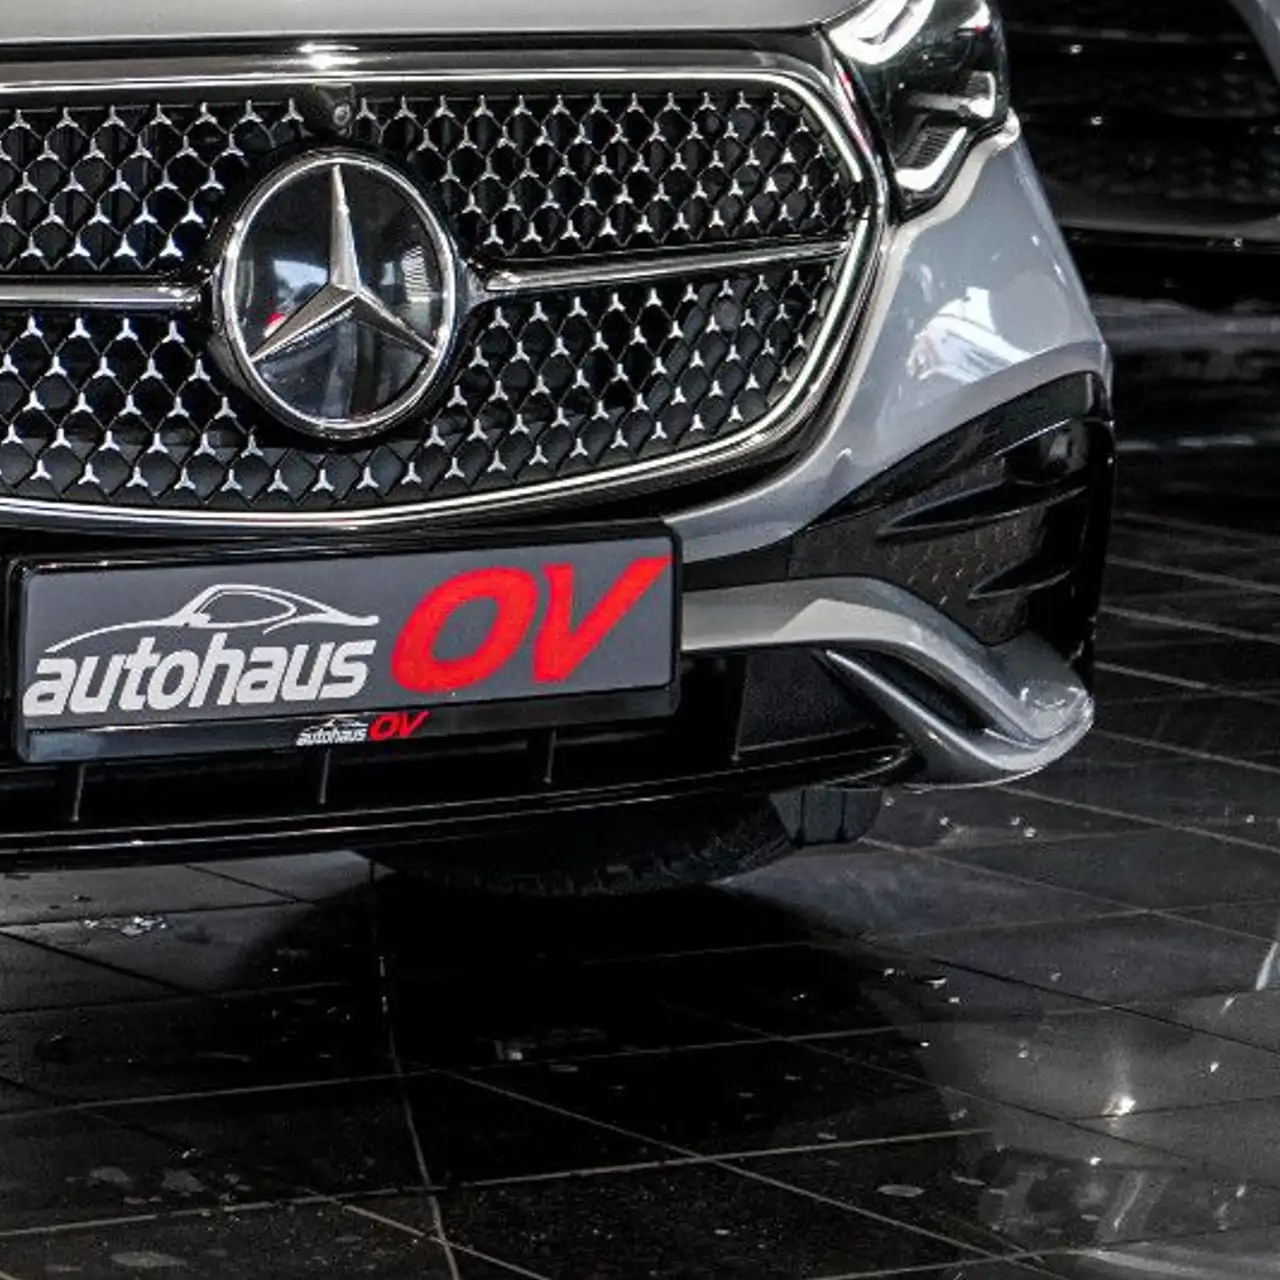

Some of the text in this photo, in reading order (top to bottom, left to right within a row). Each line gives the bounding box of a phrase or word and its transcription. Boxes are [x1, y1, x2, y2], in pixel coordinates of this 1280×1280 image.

[22, 556, 672, 717] autohaus OV
[296, 711, 429, 746] autohaus OV
